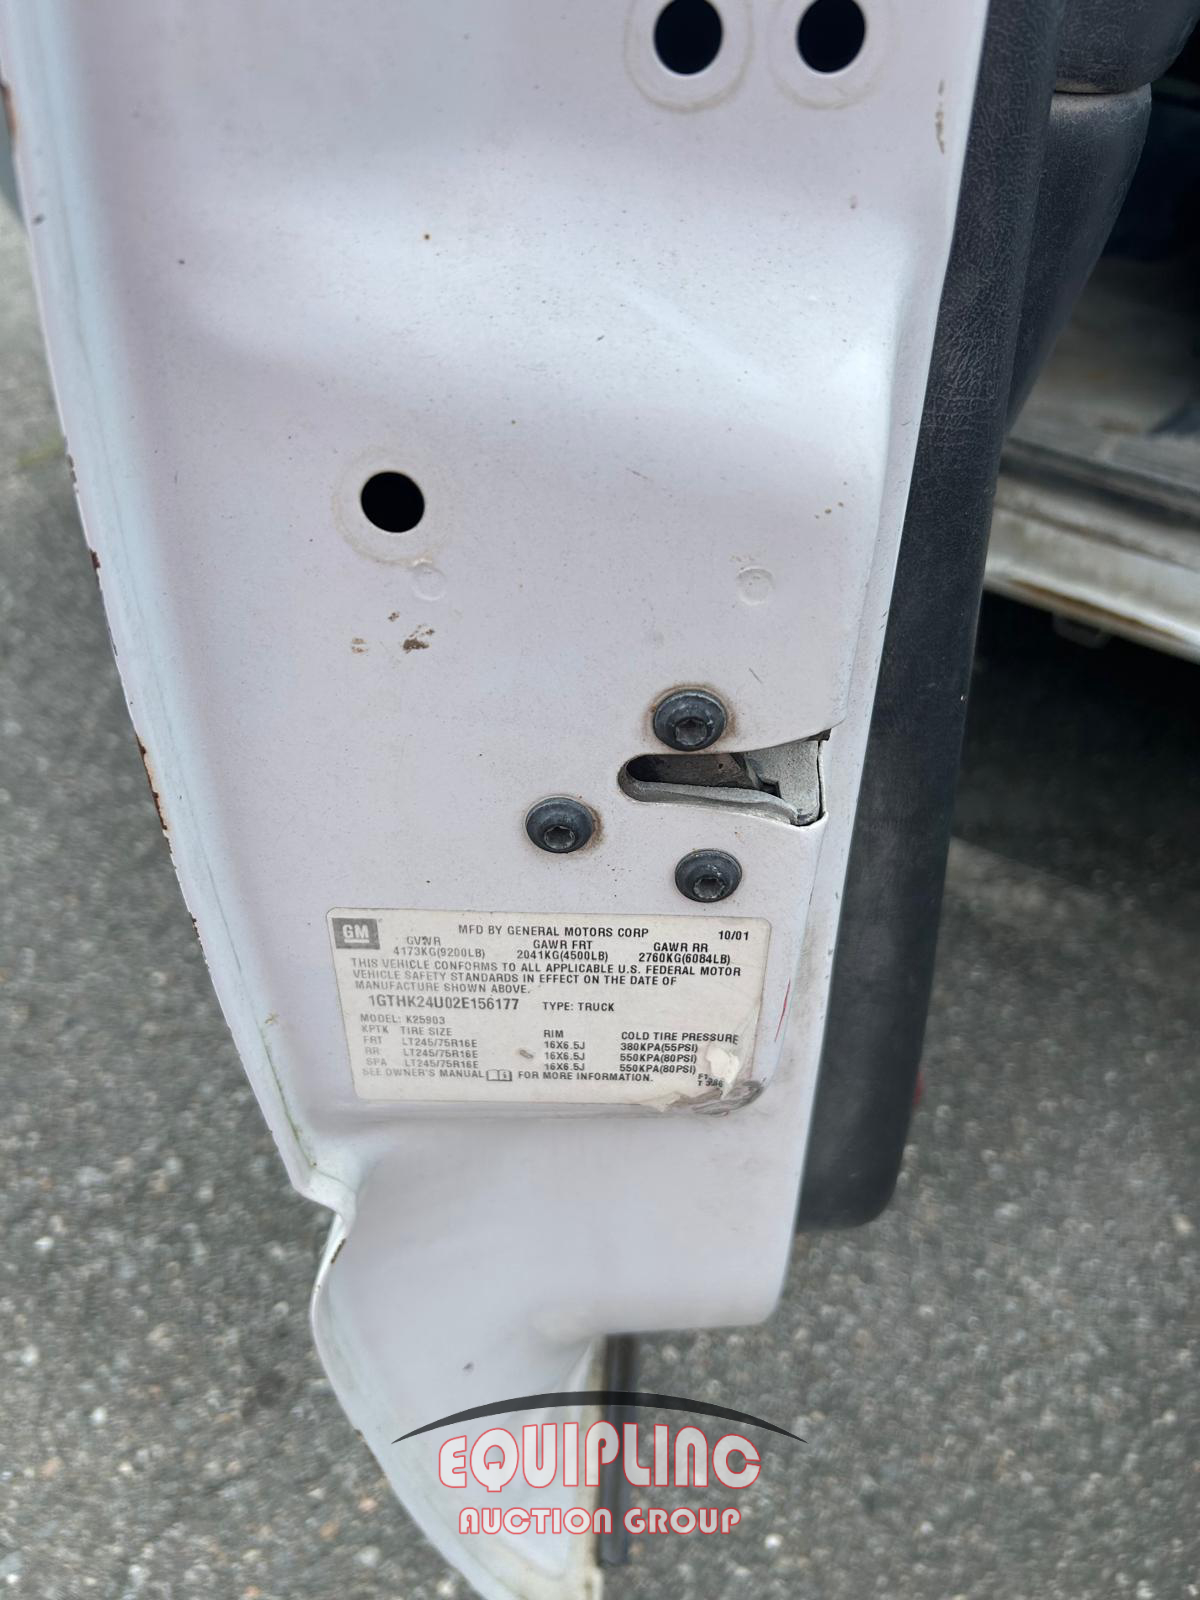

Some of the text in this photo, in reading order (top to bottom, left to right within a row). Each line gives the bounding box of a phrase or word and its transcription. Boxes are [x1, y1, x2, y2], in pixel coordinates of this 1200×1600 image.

[342, 924, 369, 939] GM
[458, 925, 649, 938] MFD BY GENERAL MOTORS CORP
[718, 931, 749, 941] 10/01
[406, 936, 441, 946] GVWR
[533, 940, 592, 950] GAWR FRT
[393, 947, 485, 958] 4173KG(9200LB)
[653, 942, 708, 952] GAWR RR
[517, 950, 608, 962] 2041KG(4500LB)
[639, 953, 731, 965] 2760KG(6084LB)
[351, 958, 741, 976] THIS VEHICLE CONFORMS TO ALL APPLICABLE U.S. FEDERAL MOTOR
[353, 969, 677, 986] VEHICLE SAFETY STANDARDS IN EFFECT ON THE DATE OF
[355, 980, 531, 994] MANUFACTURE SHOWN ABOVE.
[368, 994, 519, 1010] 1GTHK24U02E156177
[543, 1002, 615, 1012] TYPE: TRUCK
[360, 1014, 445, 1025] MODEL: K25903
[401, 1025, 452, 1036] TIRE SIZE
[544, 1030, 564, 1038] RIM
[363, 1036, 382, 1045] FRT
[402, 1037, 477, 1048] LT245/75R16E
[621, 1031, 739, 1045] COLD TIRE PRESSURE
[544, 1041, 585, 1050] 16X6.5J
[620, 1042, 698, 1053] 380KPA(55PSI)
[403, 1048, 478, 1059] LT245/75R16E
[544, 1052, 585, 1061] 16X6.5J
[620, 1053, 697, 1064] 550KPA(80PSI)
[366, 1057, 387, 1067] SPA
[404, 1058, 479, 1069] LT245/75R16E
[544, 1062, 585, 1071] 16X6.5J
[362, 1067, 653, 1082] SEE OWNER'S MANUAL FOR MORE INFORMATION.
[619, 1064, 697, 1074] 550KPA(80PSI)
